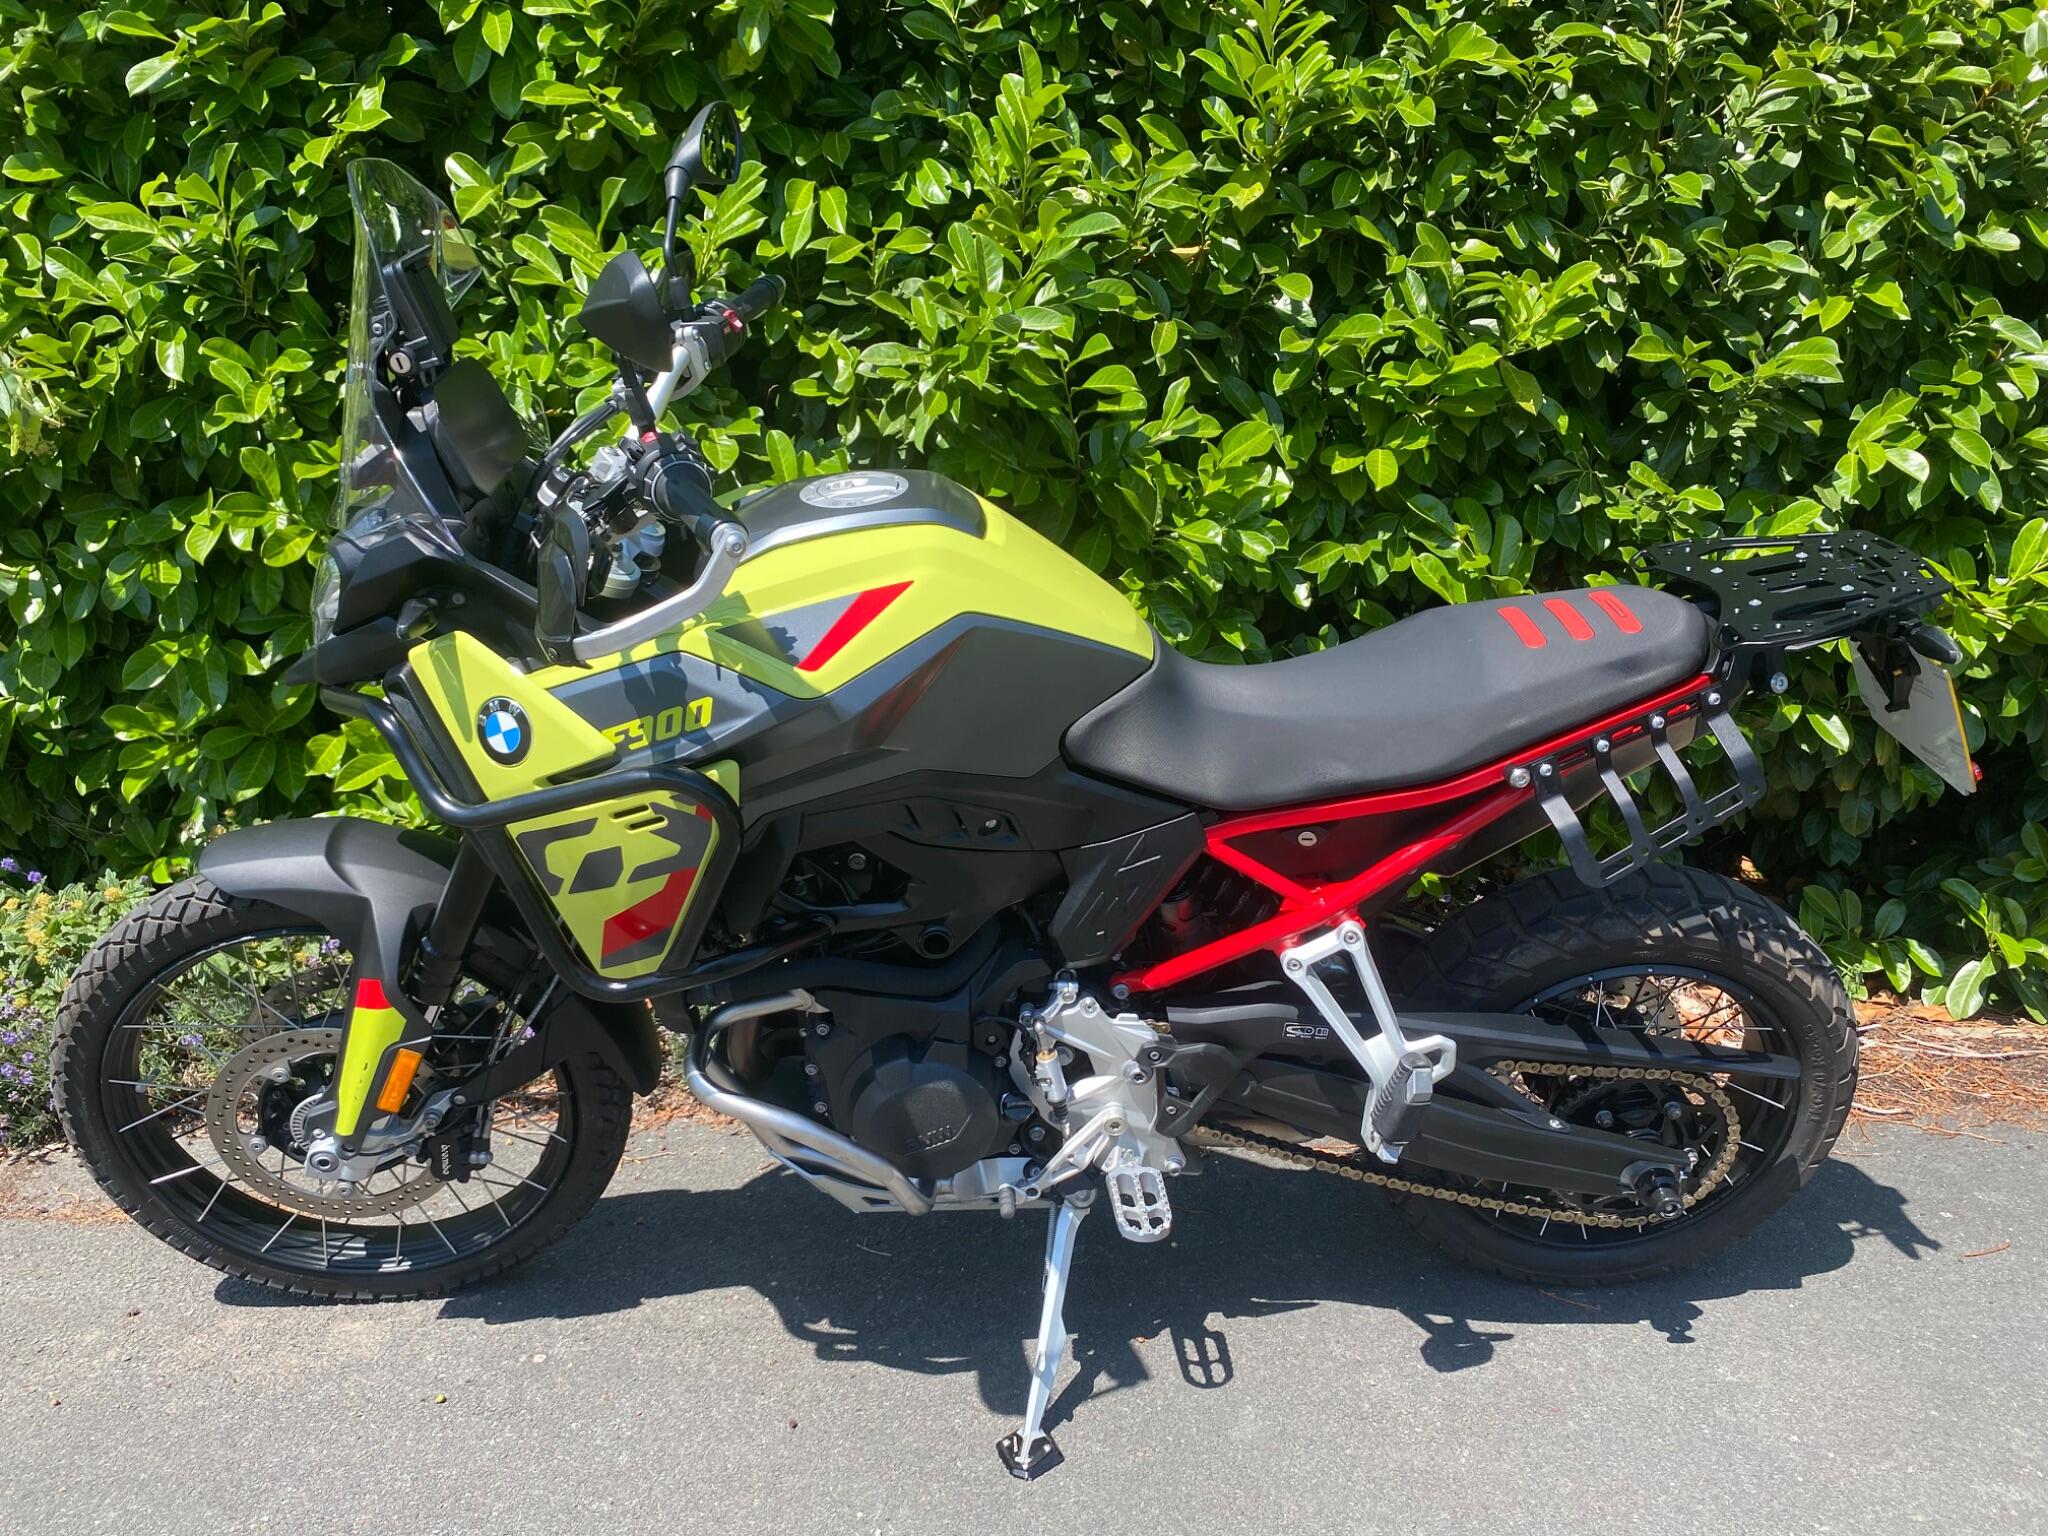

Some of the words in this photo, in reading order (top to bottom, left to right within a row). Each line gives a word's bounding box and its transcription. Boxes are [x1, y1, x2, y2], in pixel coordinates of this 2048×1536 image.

[479, 700, 520, 727] BMW
[602, 696, 713, 750] F900
[1811, 1071, 1827, 1091] 70
[441, 1144, 452, 1175] brembo
